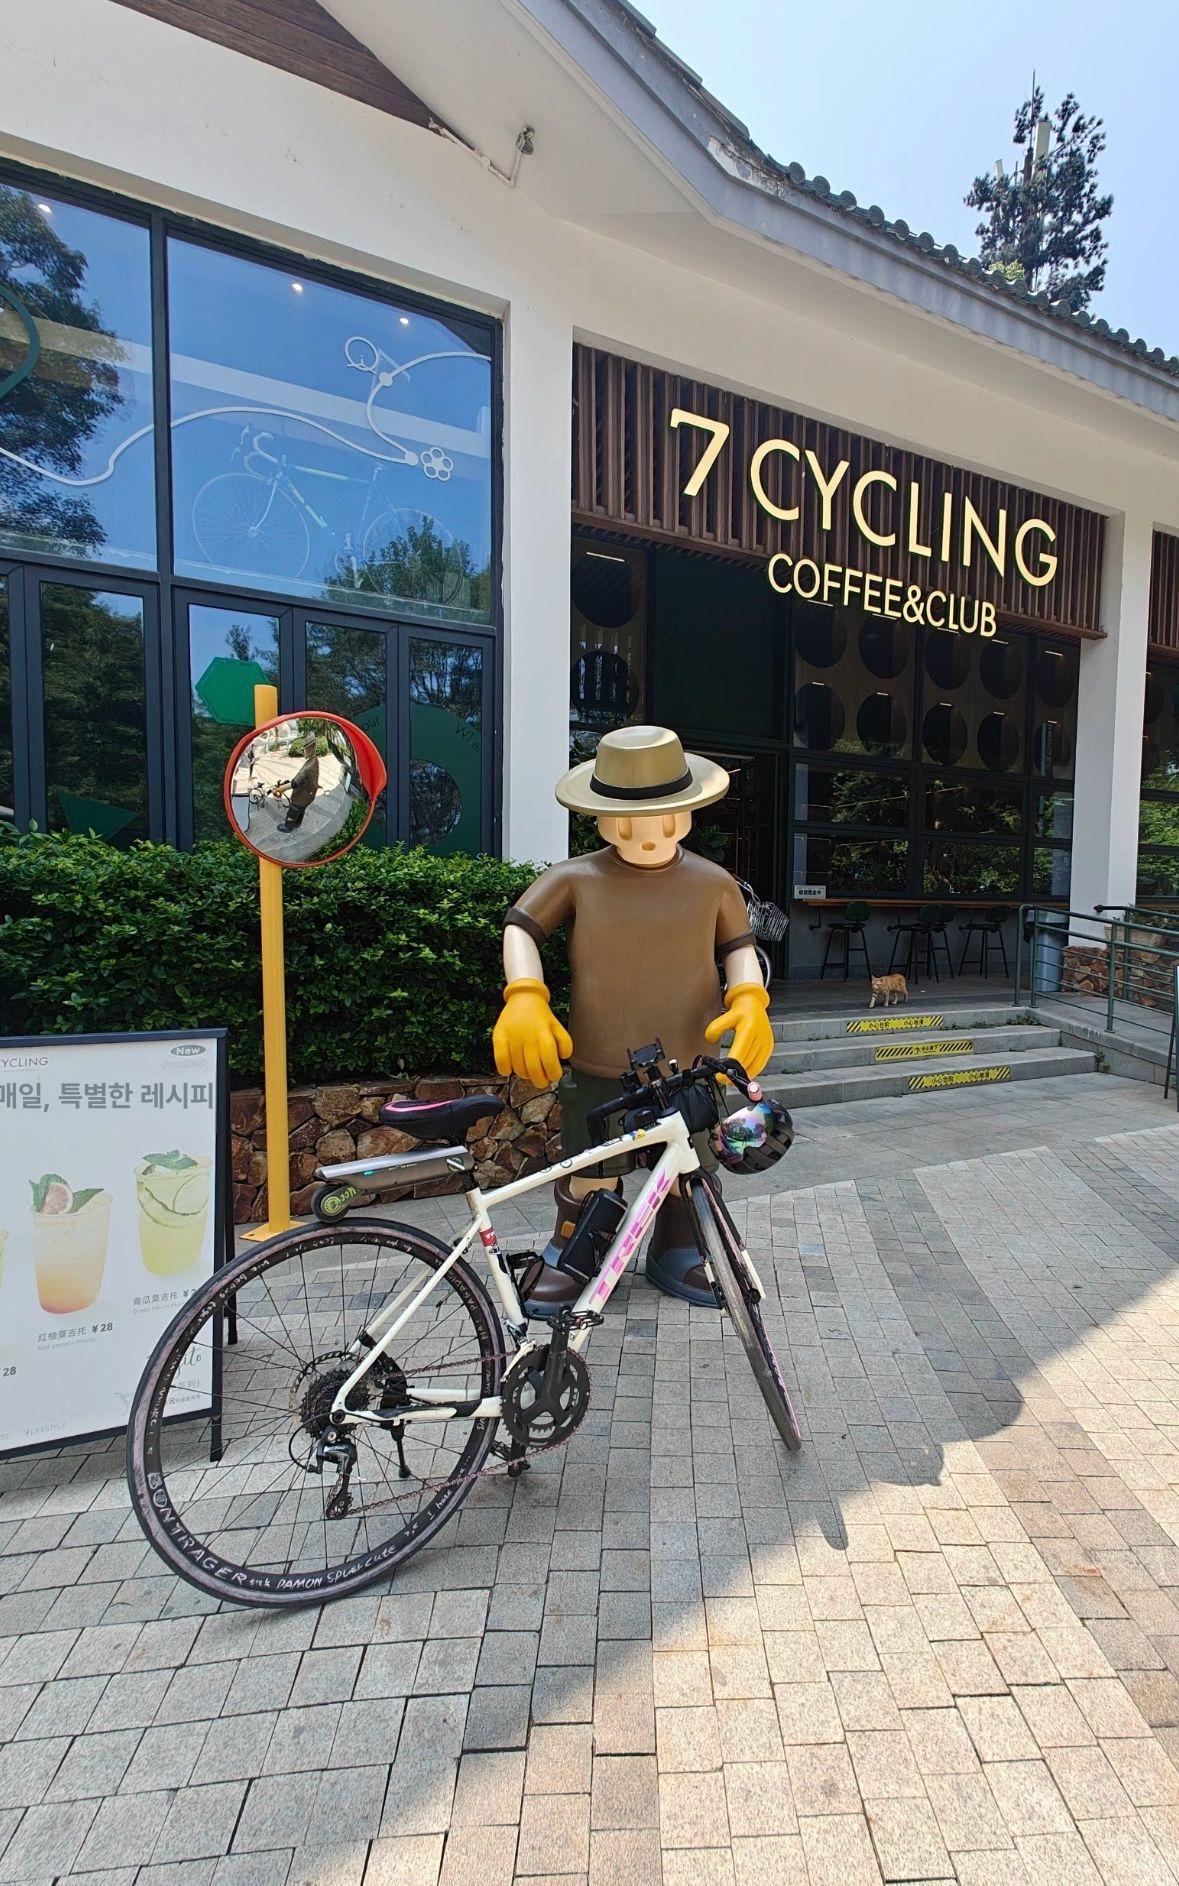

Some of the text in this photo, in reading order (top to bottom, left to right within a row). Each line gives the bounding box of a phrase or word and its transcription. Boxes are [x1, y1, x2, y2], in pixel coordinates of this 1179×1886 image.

[670, 407, 1058, 587] 7 CYCLING
[767, 552, 997, 637] COFFEE&CLUB
[0, 1056, 49, 1068] YCLING
[175, 1046, 201, 1057] New
[0, 1082, 214, 1112] 매일, 특별한 레시피
[147, 1473, 247, 1587] BONTRAGER
